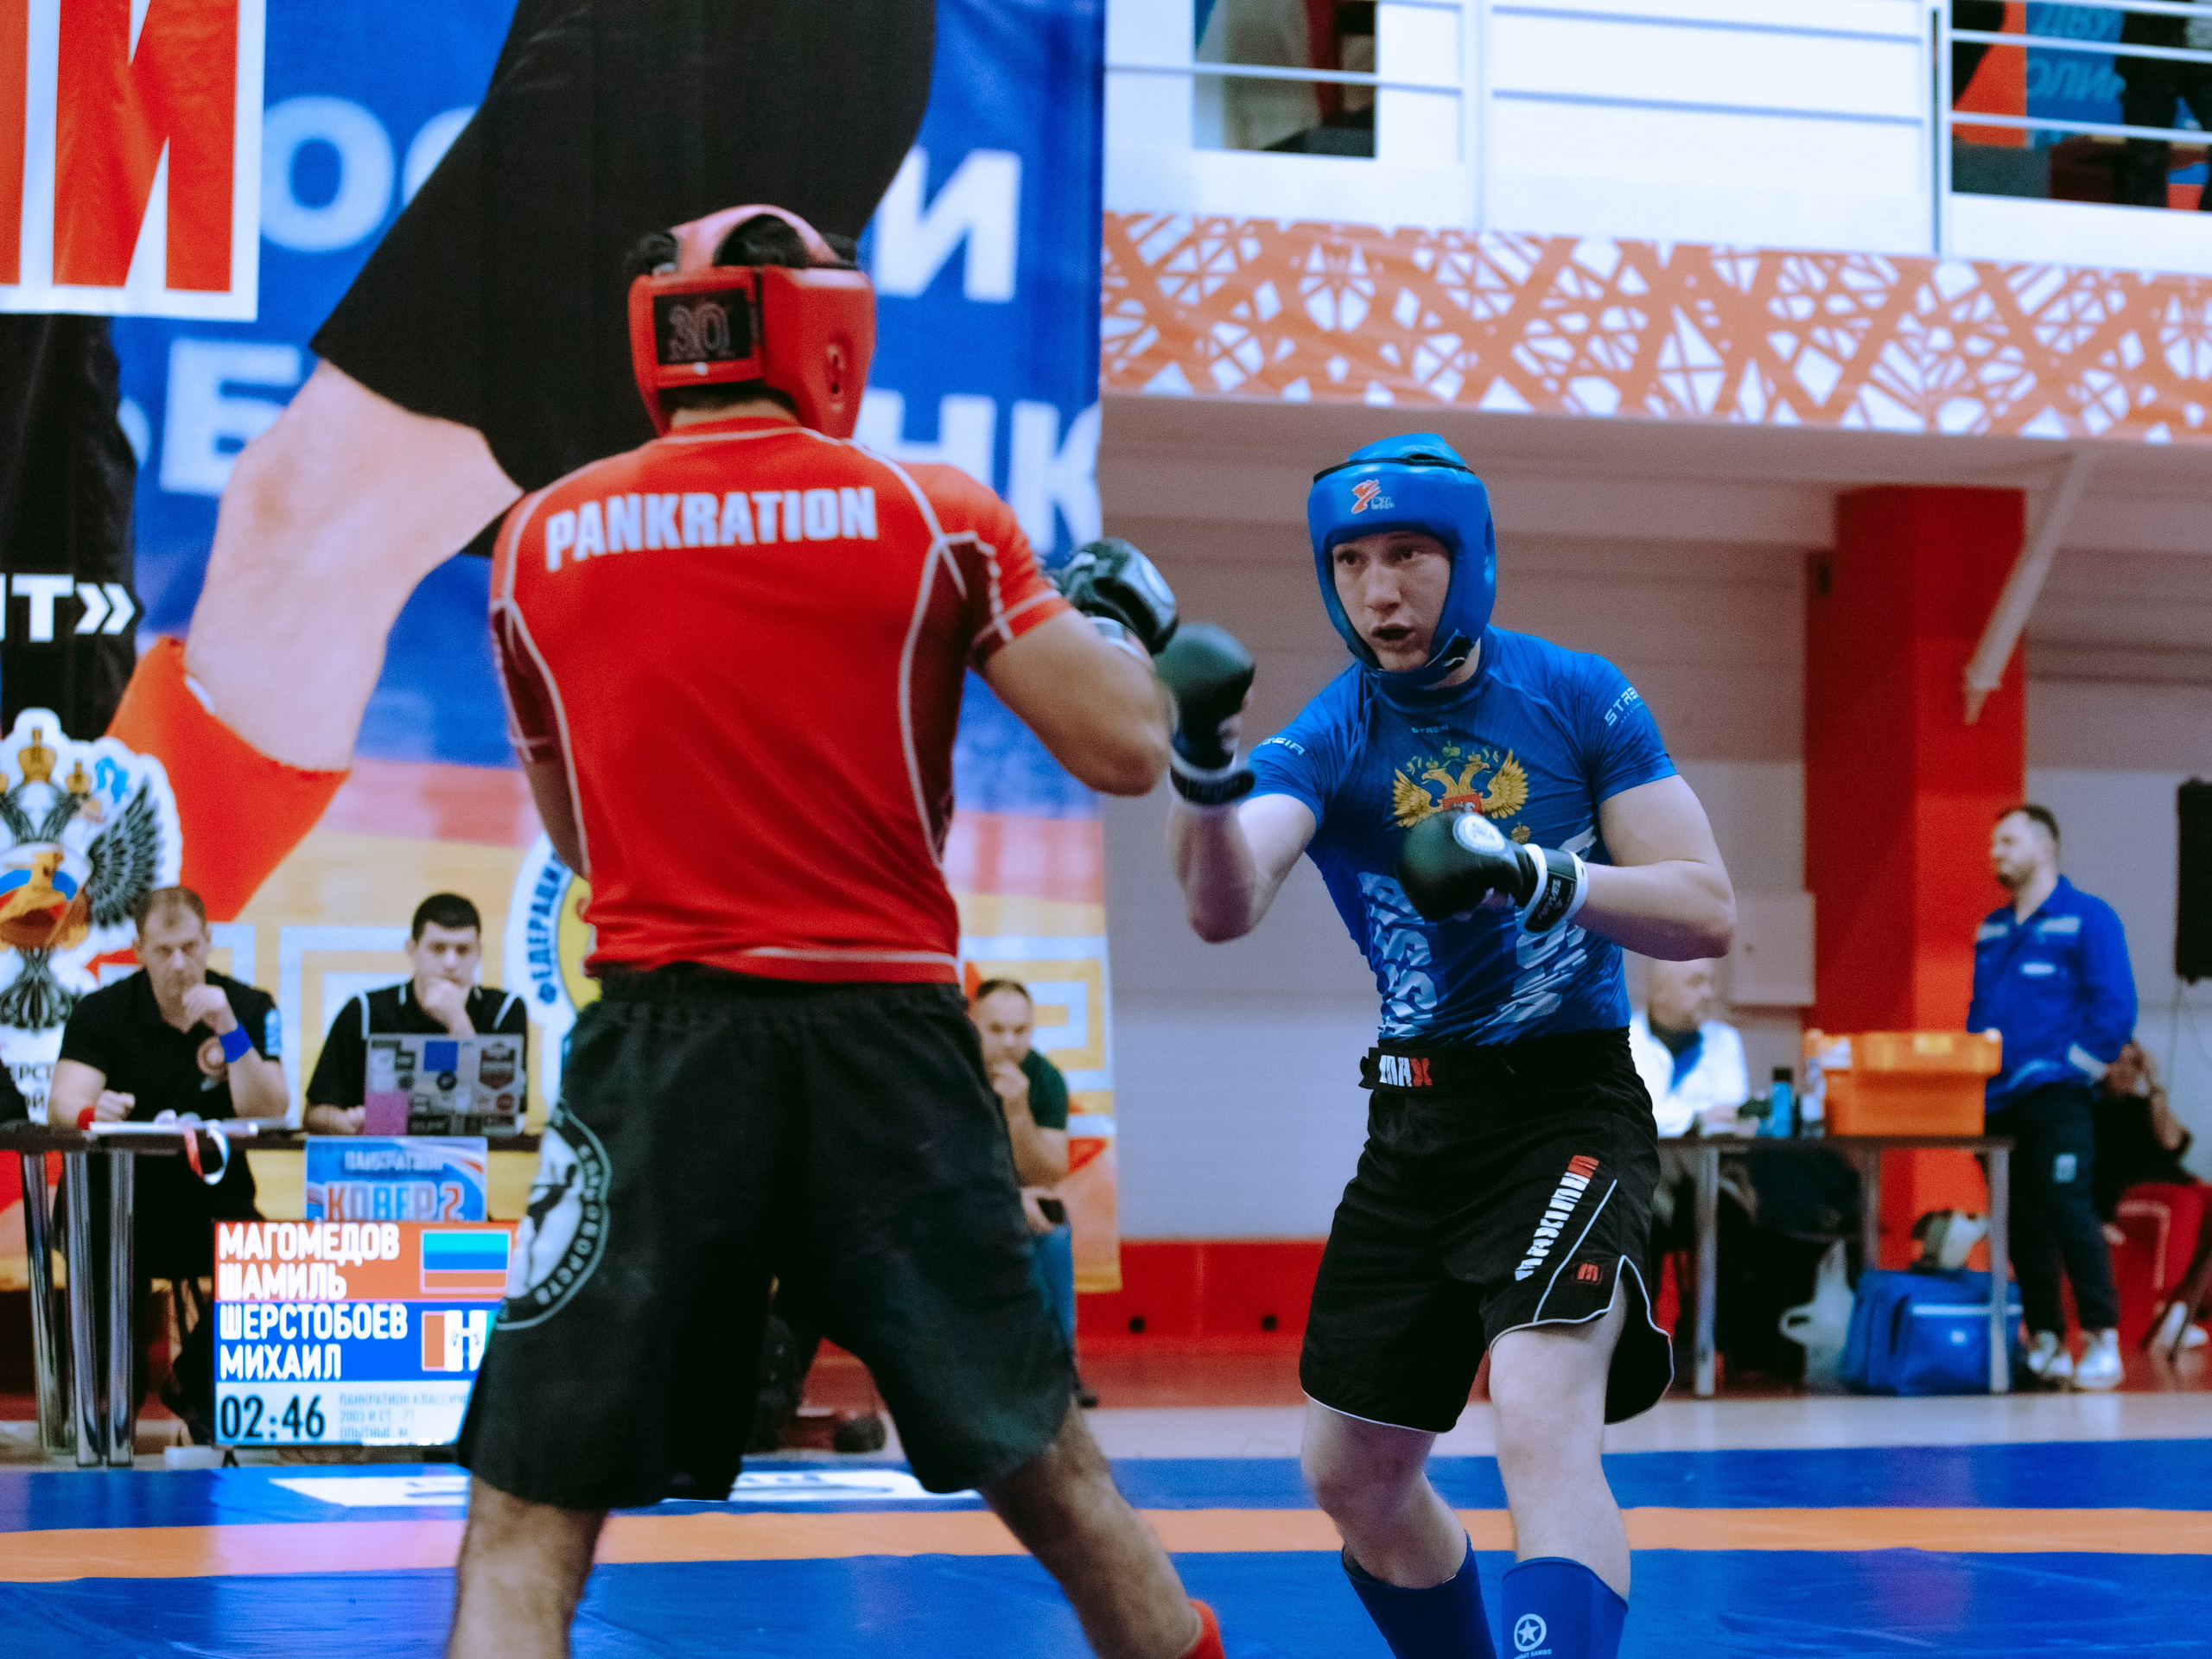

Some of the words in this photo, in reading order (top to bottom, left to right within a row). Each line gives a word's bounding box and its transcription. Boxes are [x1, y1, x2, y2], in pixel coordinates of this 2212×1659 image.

[545, 486, 878, 572] PANKRATION
[0, 573, 136, 643] Т»
[326, 1181, 437, 1222] КОВЕР
[439, 1181, 465, 1222] 2
[219, 1223, 400, 1267] МАГОМЕДОВ
[219, 1262, 347, 1301] ШАМИЛЬ
[219, 1303, 409, 1341] ШЕРСТОБОЕВ
[219, 1344, 342, 1381] МИХАИЛ
[220, 1394, 326, 1439] 02:46
